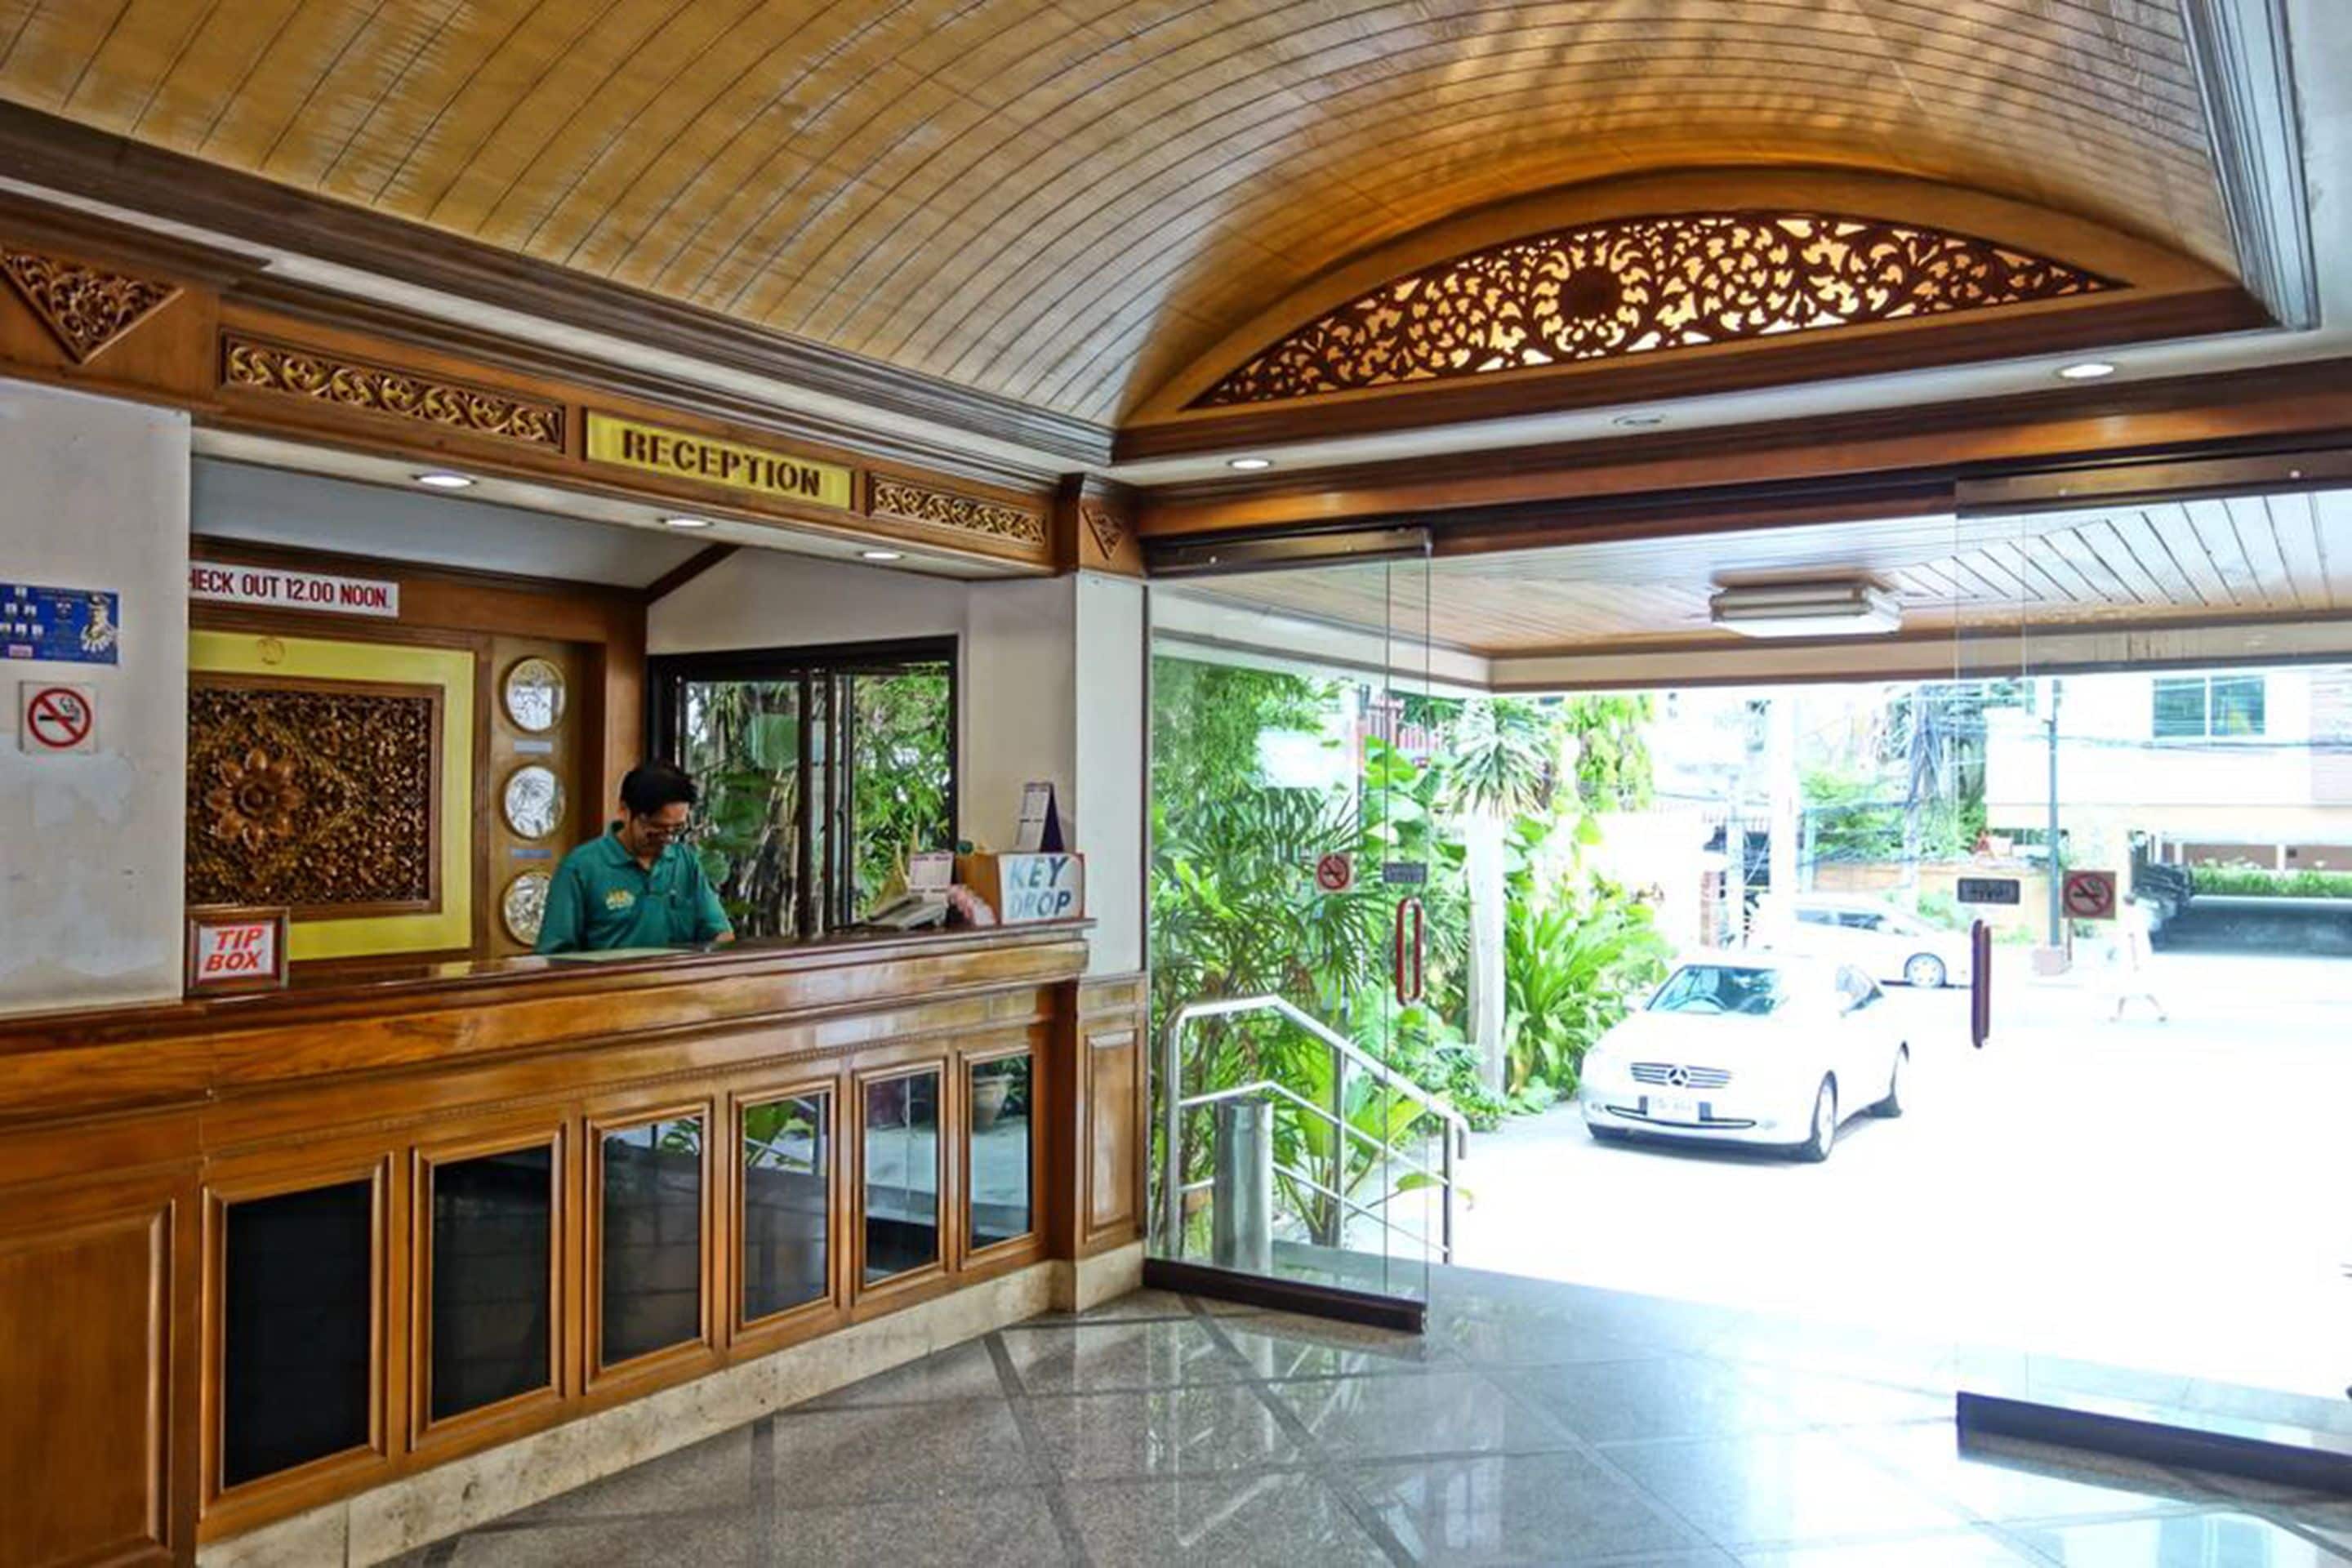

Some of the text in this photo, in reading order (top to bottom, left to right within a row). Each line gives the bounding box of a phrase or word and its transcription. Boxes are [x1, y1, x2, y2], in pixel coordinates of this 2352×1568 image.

[623, 429, 820, 497] RECEPTION
[189, 568, 234, 595] HECK
[242, 574, 279, 598] OUT
[286, 578, 334, 603] 12.00
[1010, 856, 1068, 888] KEY
[1008, 891, 1071, 918] DROP
[216, 925, 264, 951] TIP
[205, 949, 265, 972] BOX
